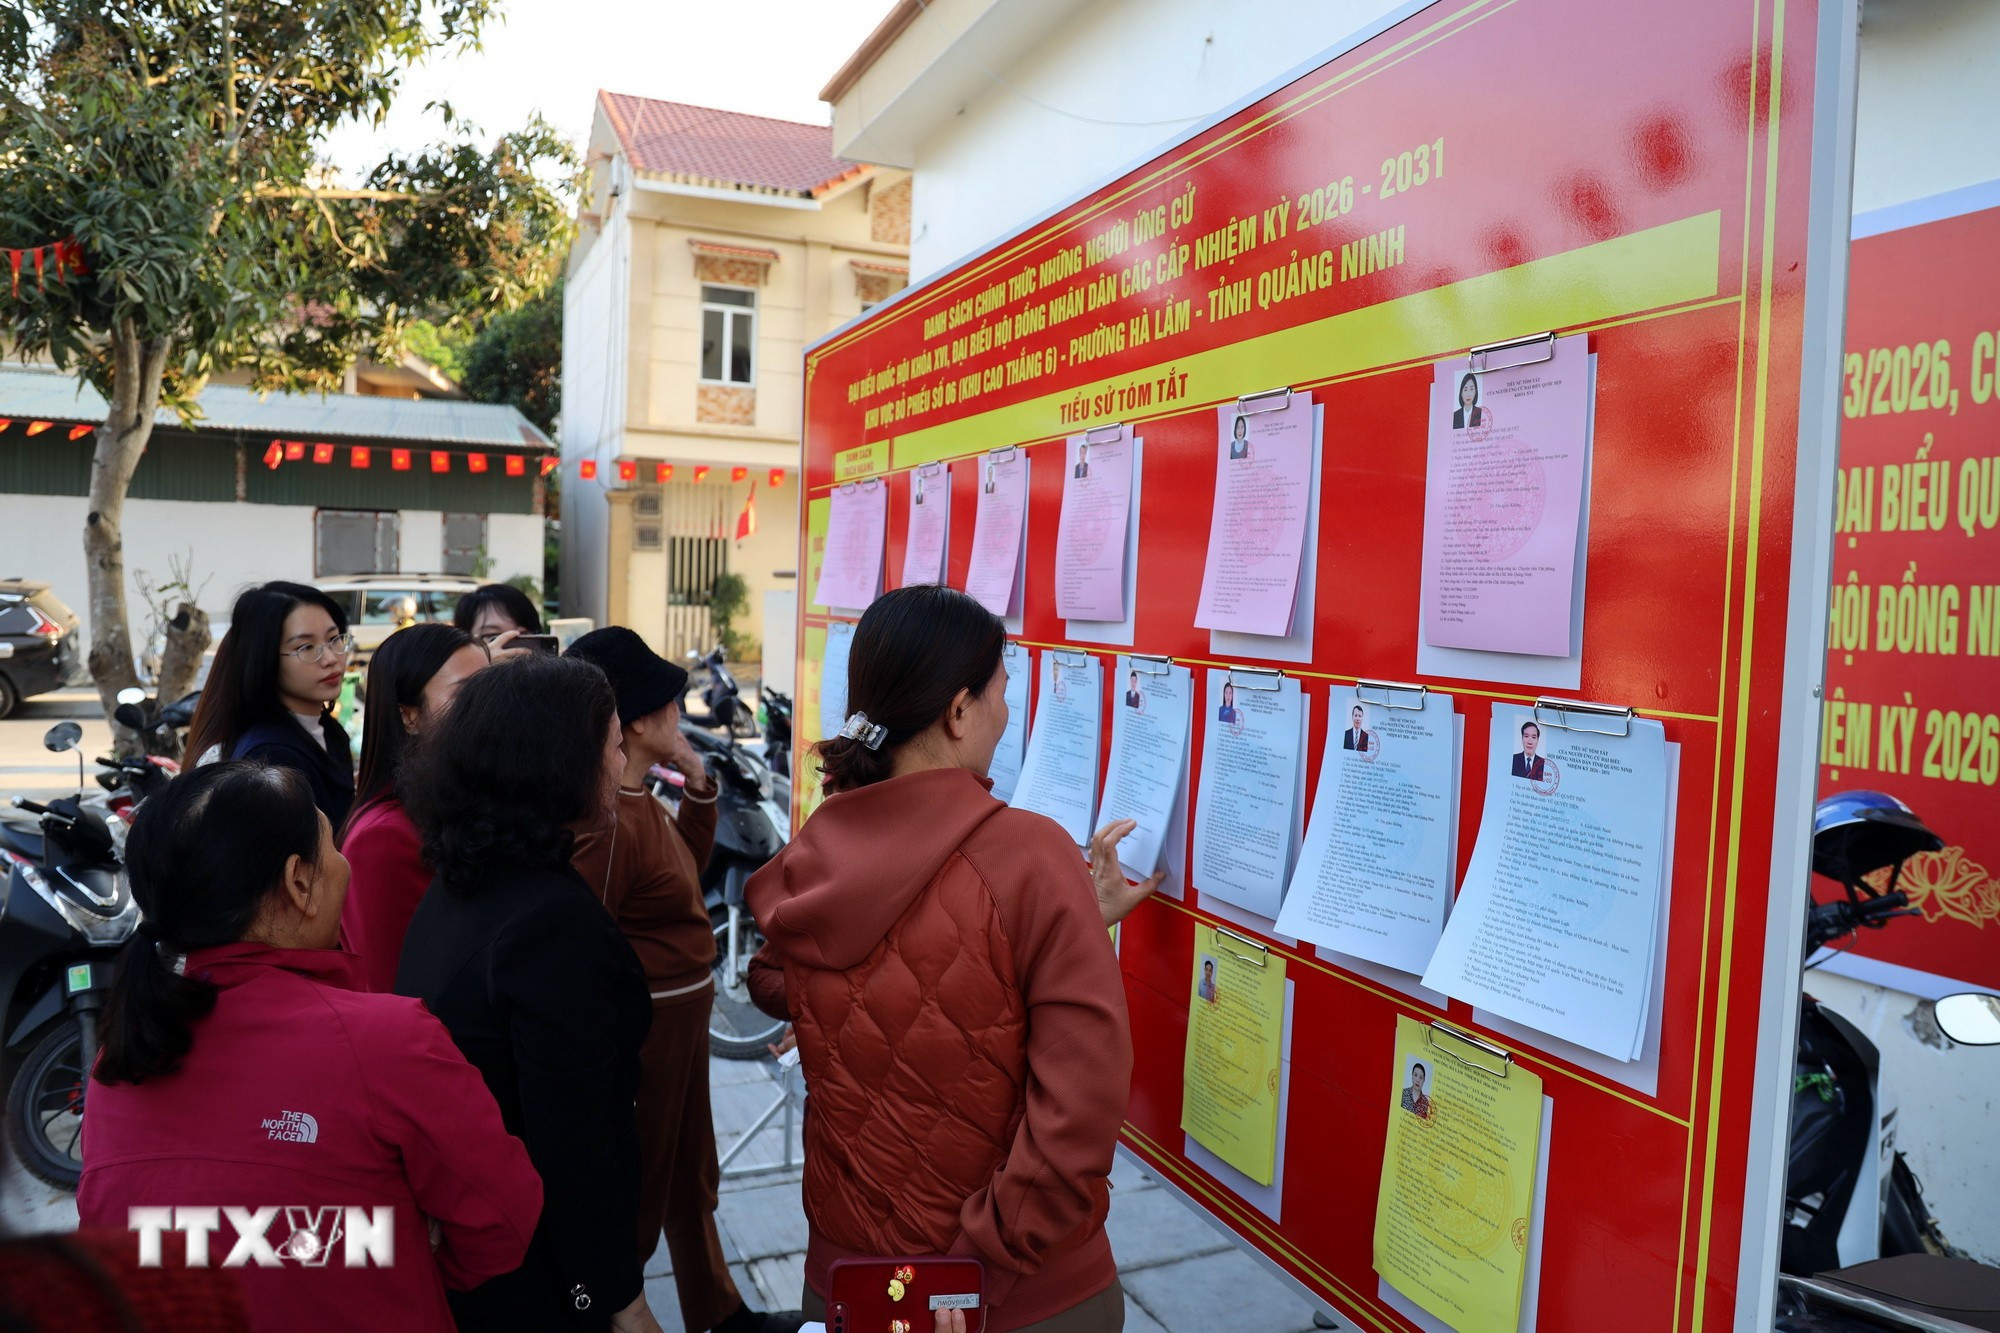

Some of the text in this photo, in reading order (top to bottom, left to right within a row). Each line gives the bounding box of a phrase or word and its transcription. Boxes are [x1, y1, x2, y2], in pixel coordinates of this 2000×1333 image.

[876, 361, 895, 393] QUỐC
[896, 357, 910, 387] HỘI
[911, 349, 932, 379] KHÓA
[952, 336, 968, 366] ĐẠI
[970, 319, 992, 357] BIỂU
[994, 315, 1012, 350] HỘI
[1015, 301, 1046, 340] ĐỒNG
[1049, 286, 1084, 326] NHÂN
[1088, 273, 1117, 311] DÂN
[1120, 254, 1151, 298] CÁC
[1156, 236, 1190, 285] CẤP
[1195, 216, 1257, 271] NHIỆM
[1263, 196, 1291, 244] KỲ
[1297, 175, 1353, 231] 2026
[1379, 138, 1446, 200] 2031
[923, 181, 1196, 340] DANH SÁCH CHÍNH THỨC NHỮNG NGƯỜI ỨNG CỬ
[907, 384, 930, 417] PHIẾU
[932, 376, 945, 409] SỐ
[945, 381, 956, 405] 06
[959, 372, 981, 403] (KHU
[983, 364, 1003, 393] CAO
[1006, 346, 1042, 386] THẮNG
[1045, 346, 1057, 375] 6)
[1070, 322, 1125, 367] PHƯỜNG
[1130, 308, 1149, 347] HÀ
[1155, 294, 1190, 340] LẦM
[1208, 276, 1252, 323] TỈNH
[1258, 250, 1333, 310] QUẢNG
[1341, 224, 1405, 282] NINH
[1060, 367, 1188, 424] TIỂU SỬ TÓM TẮT
[1843, 330, 2000, 418] 3/2026, C
[1880, 431, 1950, 532] BIỂU
[1876, 560, 1959, 656] ĐỒNG
[1877, 691, 1919, 775] KỲ
[1922, 708, 2000, 787] 2026
[261, 1119, 300, 1131] NORTH
[268, 1130, 297, 1141] FACE
[281, 1110, 302, 1121] THE
